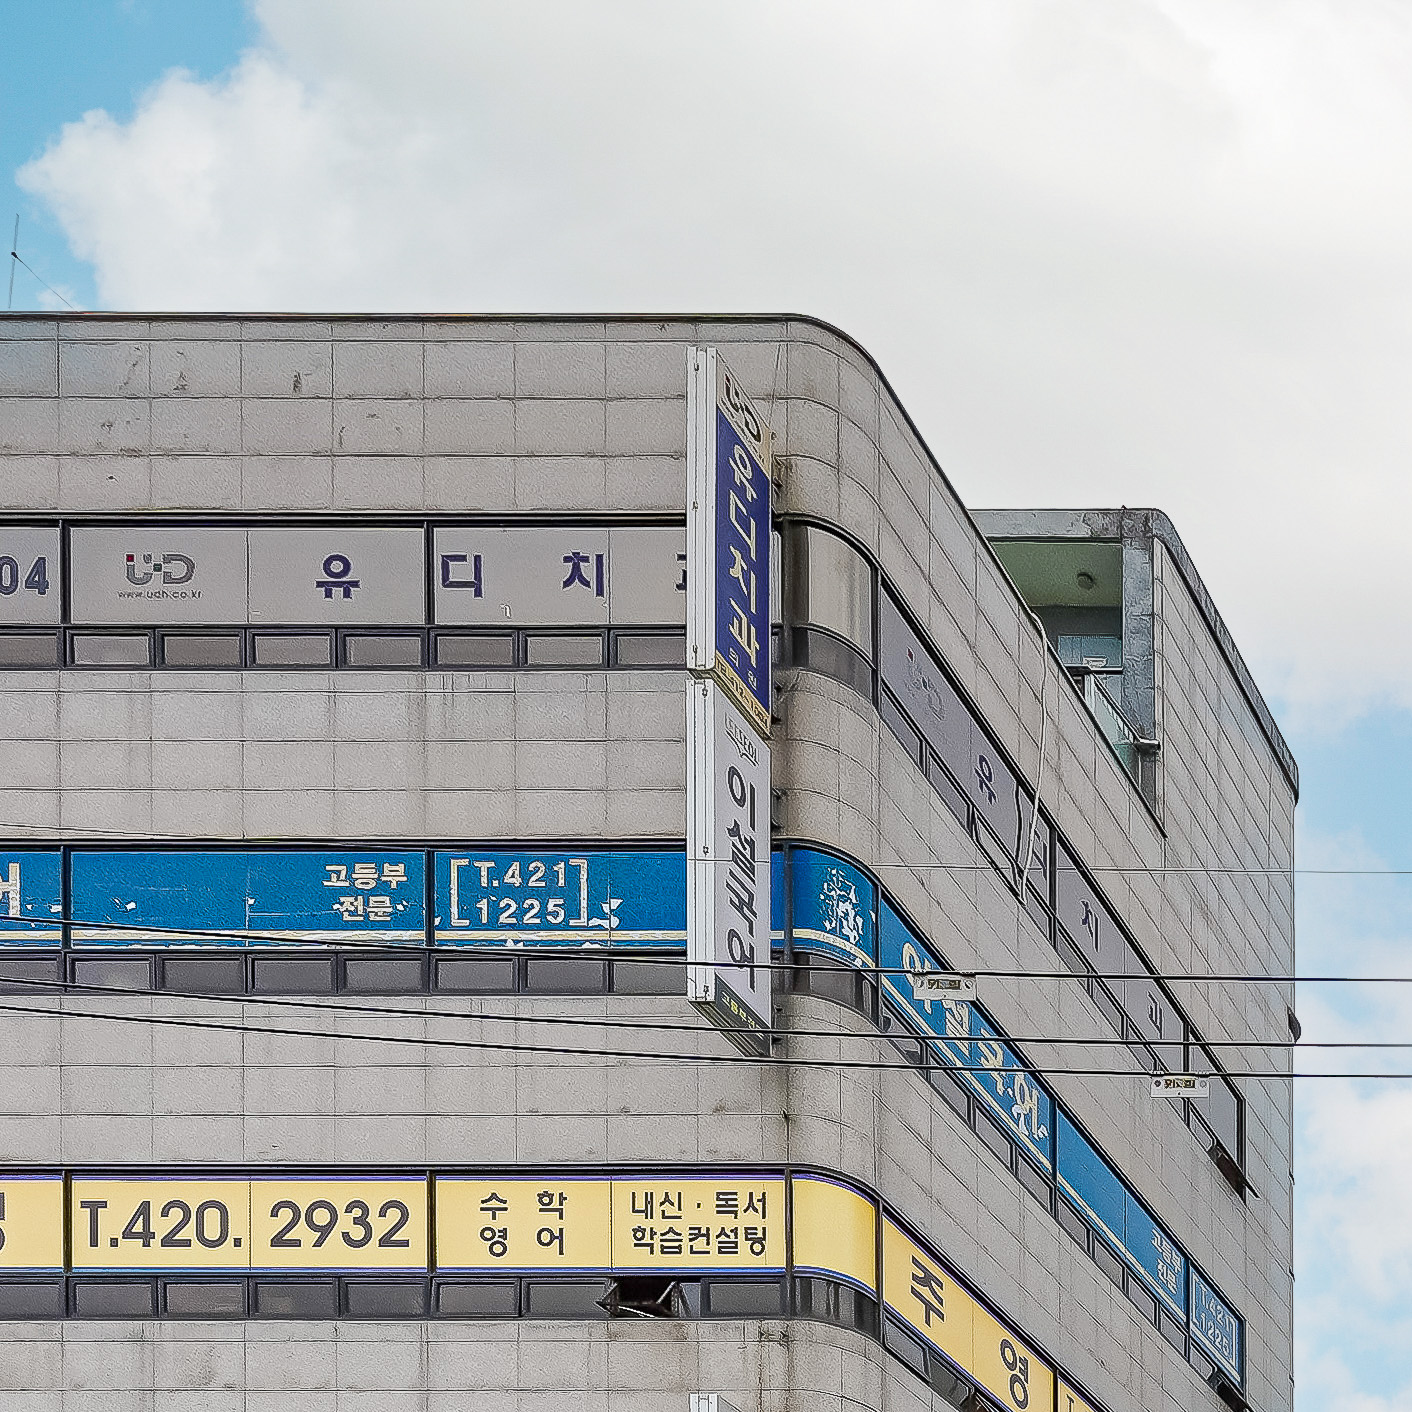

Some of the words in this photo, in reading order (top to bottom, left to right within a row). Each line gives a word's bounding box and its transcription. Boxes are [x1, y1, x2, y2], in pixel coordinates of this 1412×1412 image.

[322, 863, 407, 889] 고등부
[473, 859, 569, 889] T.421
[337, 894, 396, 923] 전문
[476, 895, 564, 926] 1225
[632, 1192, 682, 1219] 내신
[715, 1192, 766, 1219] 독서
[80, 1200, 242, 1248] T.420.
[270, 1200, 409, 1248] 2932
[632, 1226, 766, 1256] 학습컨설팅
